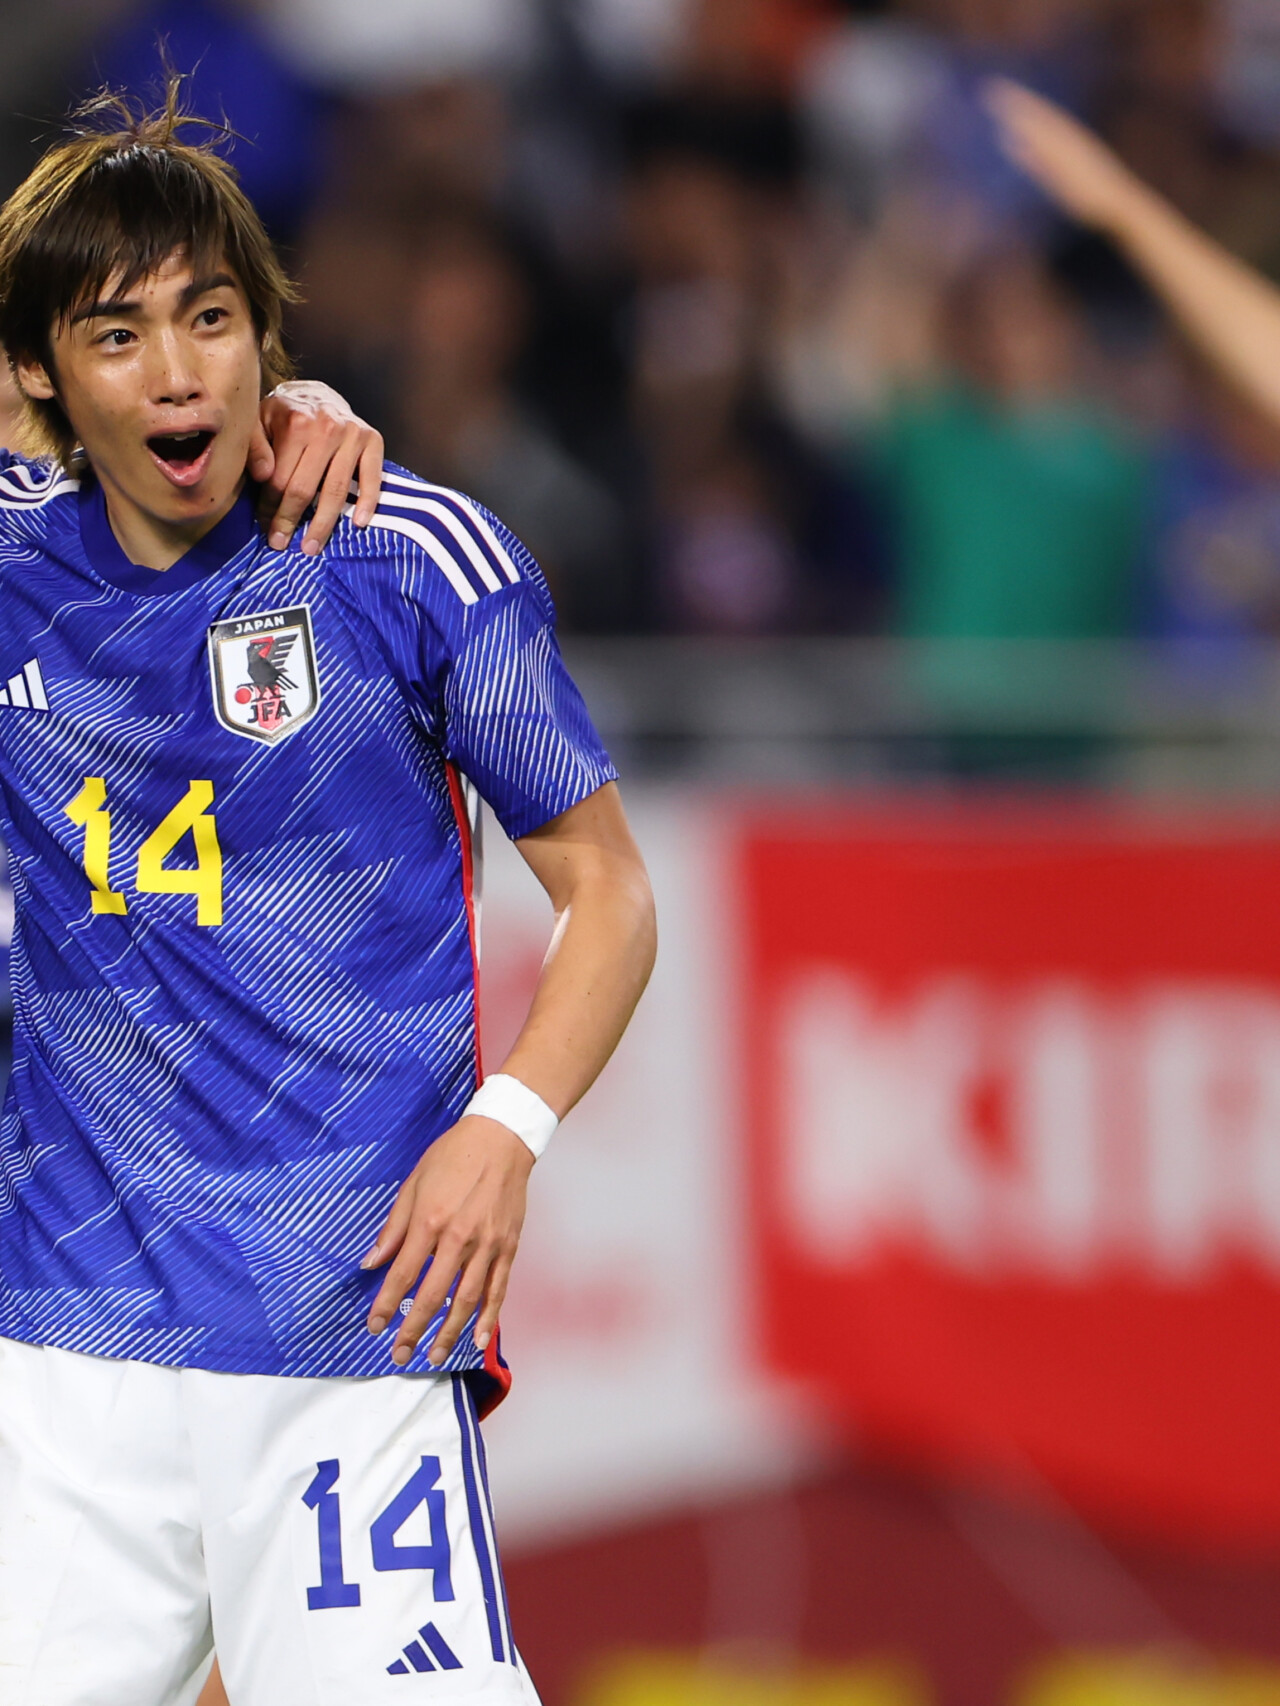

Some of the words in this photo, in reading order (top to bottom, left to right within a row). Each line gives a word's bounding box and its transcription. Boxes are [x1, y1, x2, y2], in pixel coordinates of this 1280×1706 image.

[234, 615, 285, 635] JAPAN
[247, 701, 292, 723] JFA
[64, 777, 223, 926] 14
[301, 1455, 456, 1611] 14
